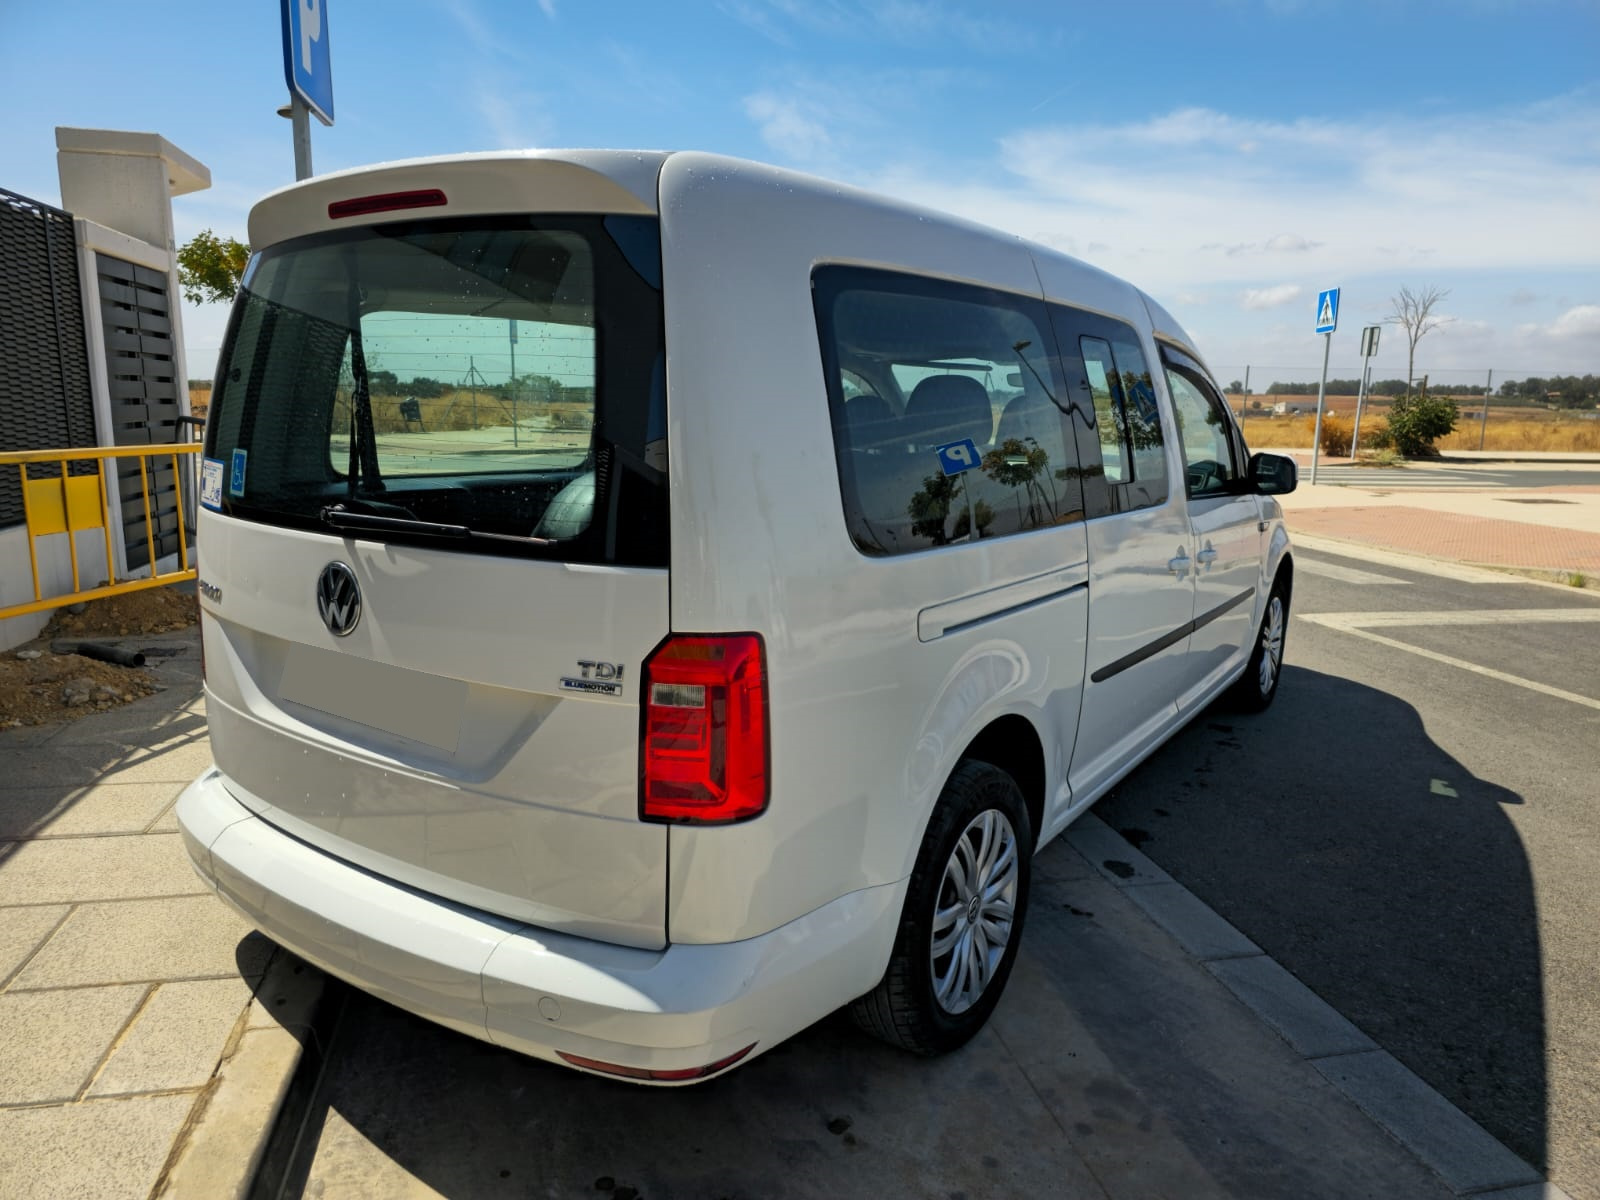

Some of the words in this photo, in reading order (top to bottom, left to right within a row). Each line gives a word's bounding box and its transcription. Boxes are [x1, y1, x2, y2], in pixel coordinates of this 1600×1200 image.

[299, 0, 321, 76] P
[577, 660, 624, 680] TDI
[564, 679, 616, 692] BLUEMOTION
